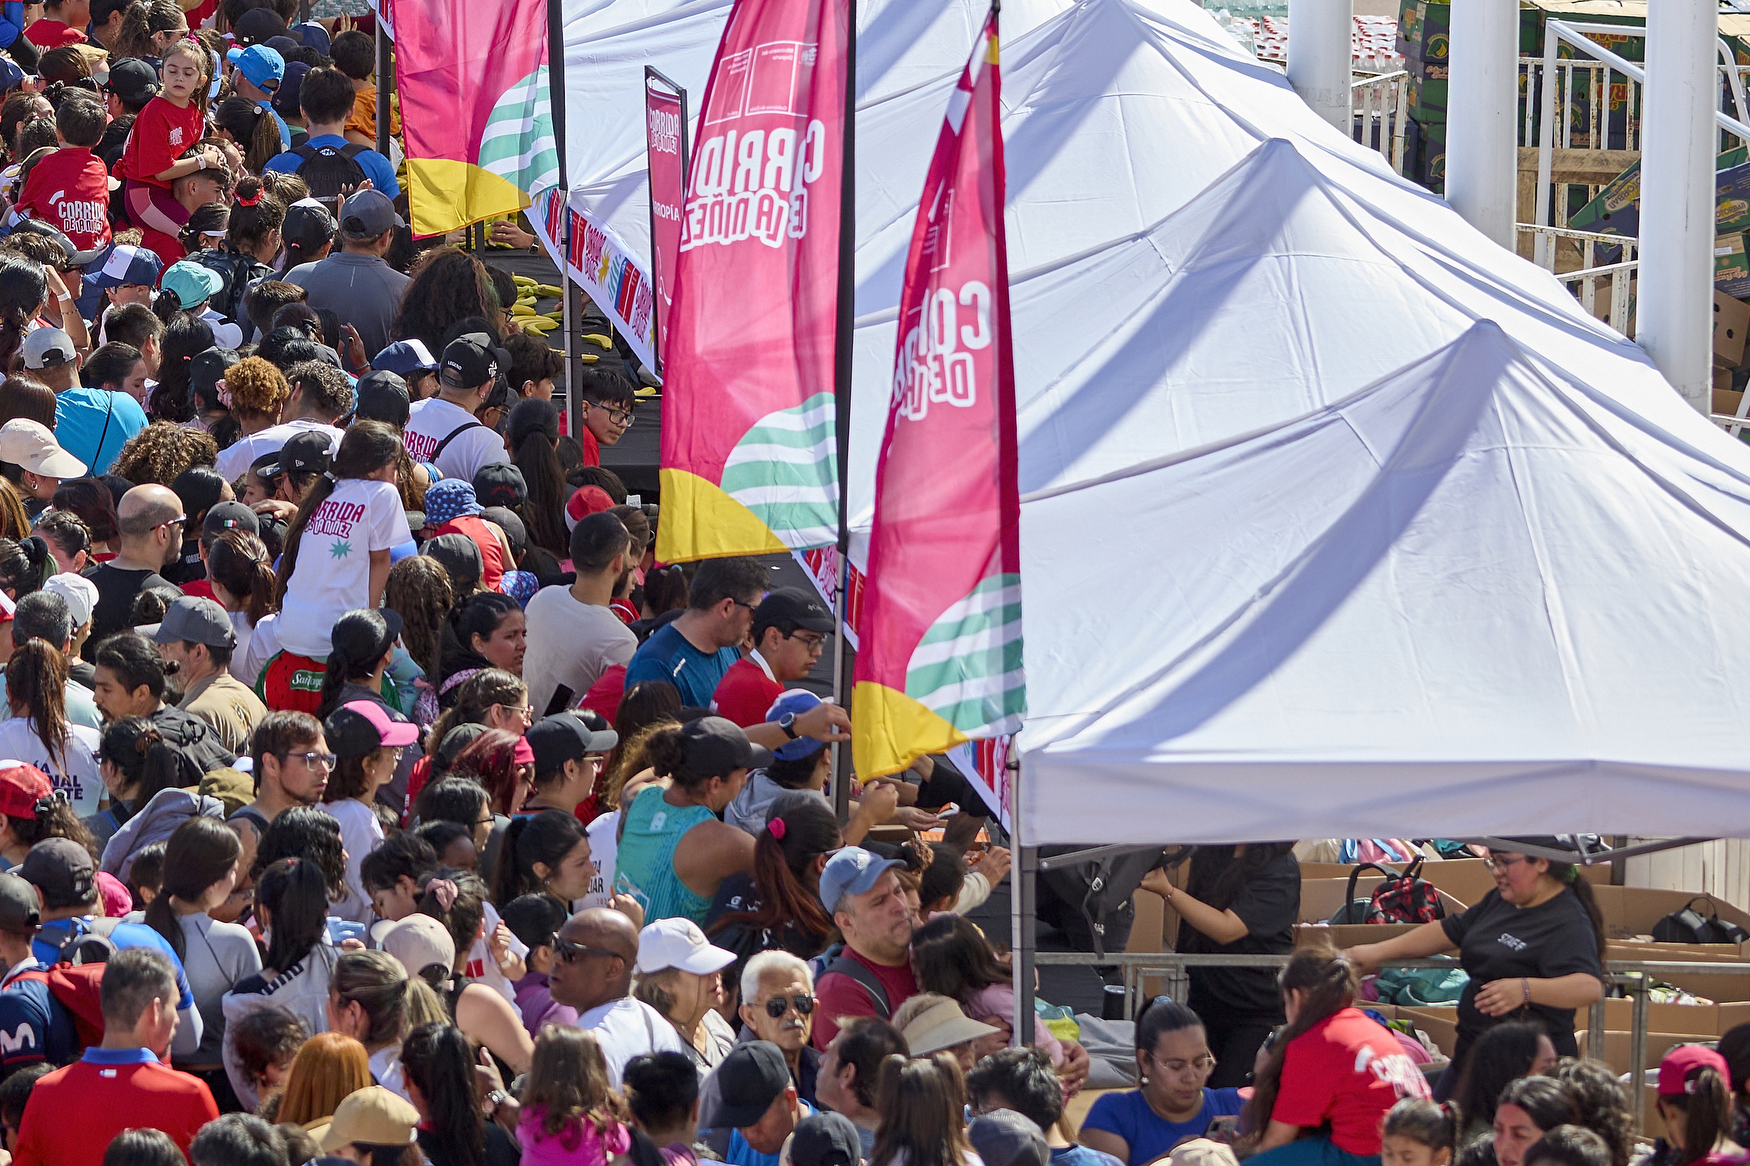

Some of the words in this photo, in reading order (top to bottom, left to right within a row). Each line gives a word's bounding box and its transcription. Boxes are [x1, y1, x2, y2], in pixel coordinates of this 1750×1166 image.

[58, 200, 105, 221] CORRIDA
[64, 219, 76, 232] DE
[447, 361, 462, 371] LEGEND
[1497, 933, 1527, 952] STAFF
